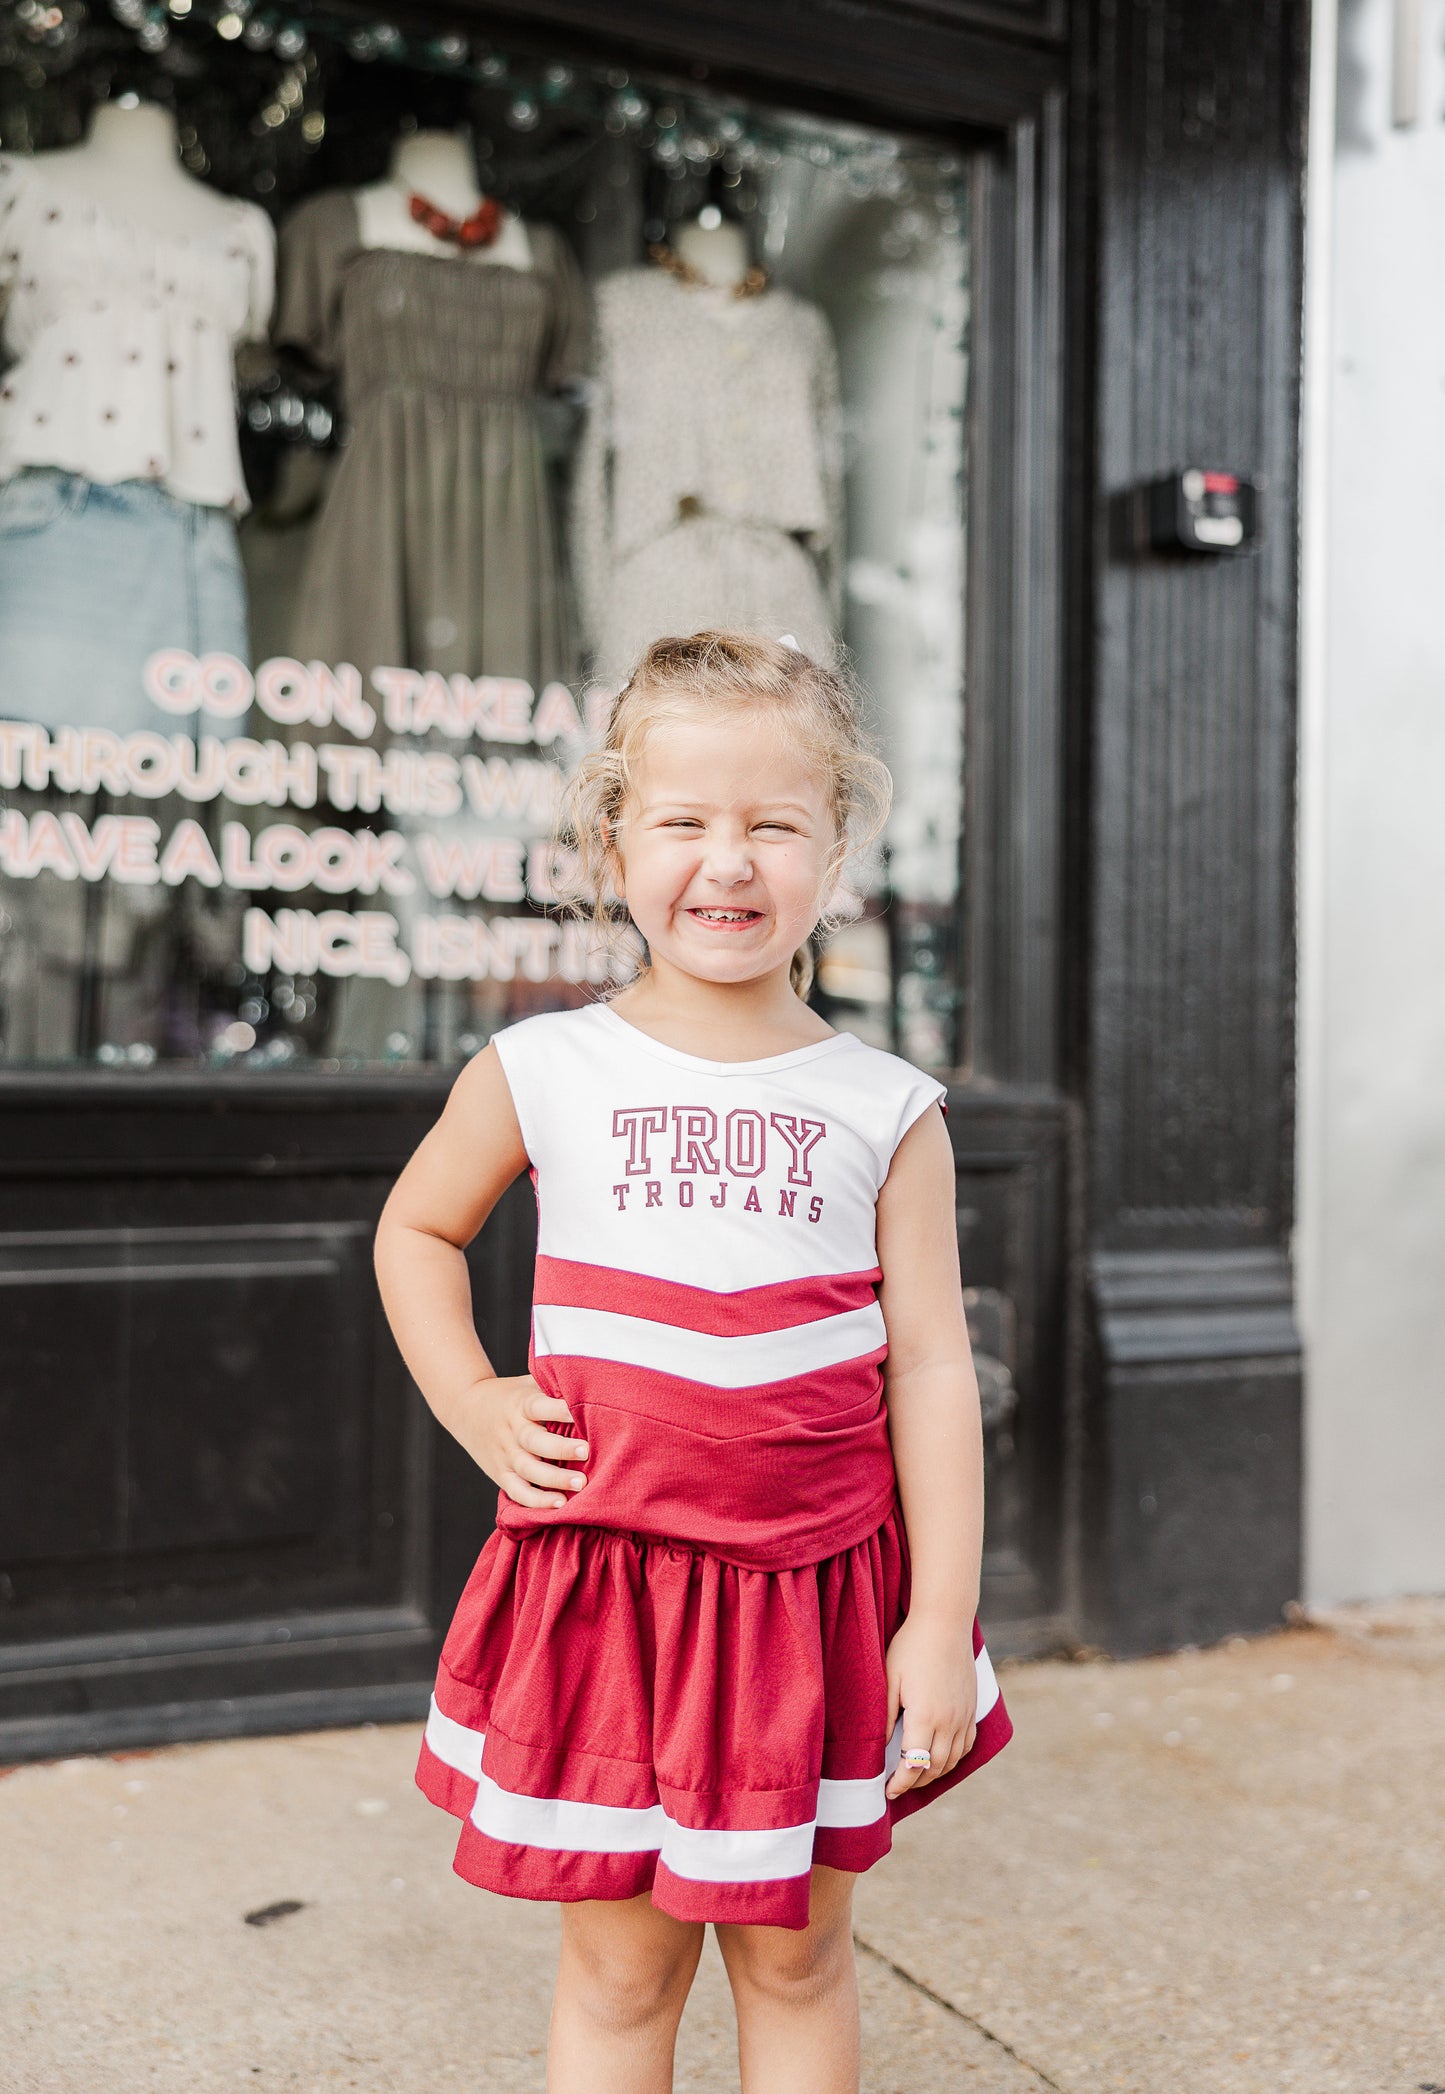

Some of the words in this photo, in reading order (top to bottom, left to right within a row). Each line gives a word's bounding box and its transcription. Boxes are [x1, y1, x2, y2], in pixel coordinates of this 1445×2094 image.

[145, 648, 254, 718] GO
[372, 665, 534, 744] TAKE
[533, 682, 585, 745] A
[0, 721, 317, 808] THROUGH
[318, 744, 462, 817] THIS
[161, 819, 223, 888] A
[415, 833, 526, 903] WE
[612, 1106, 826, 1187] TROY
[613, 1181, 823, 1223] TROJANS
